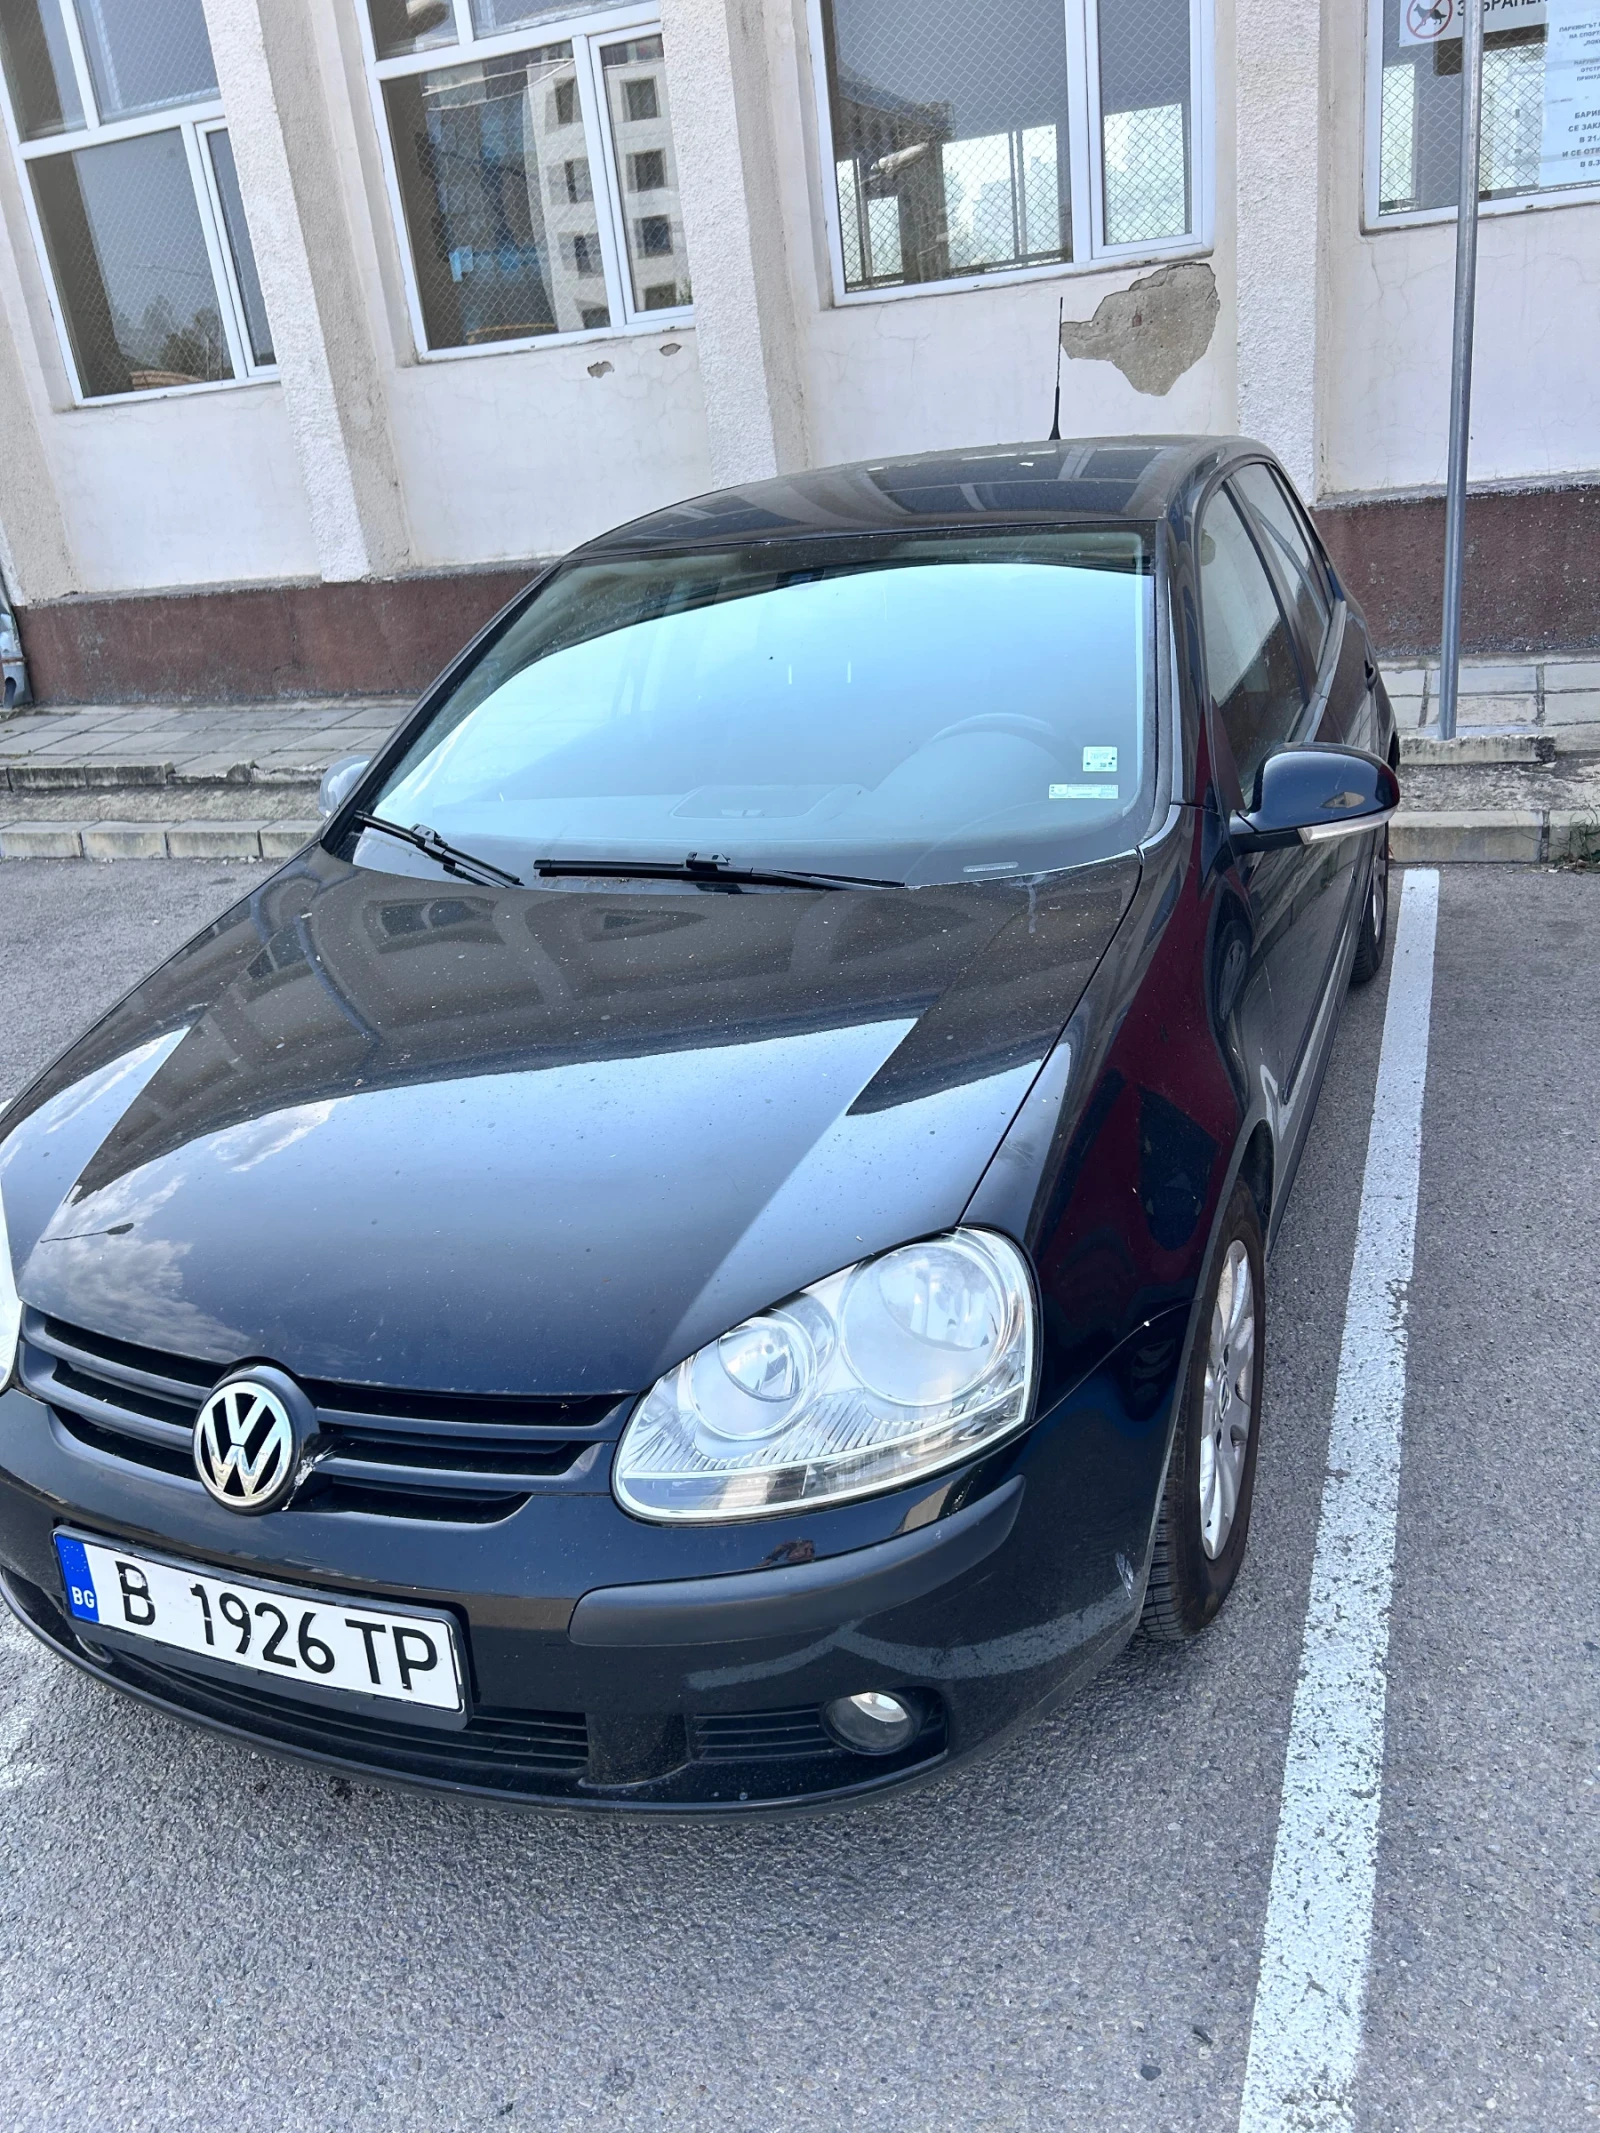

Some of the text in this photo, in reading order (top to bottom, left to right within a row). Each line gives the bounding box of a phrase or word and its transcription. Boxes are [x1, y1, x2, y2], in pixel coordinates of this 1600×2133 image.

[1568, 124, 1579, 132] СЕ
[1570, 149, 1581, 157] СЕ
[193, 1382, 293, 1507] VW
[71, 1586, 96, 1609] BG
[114, 1560, 439, 1691] B 1926 TP
